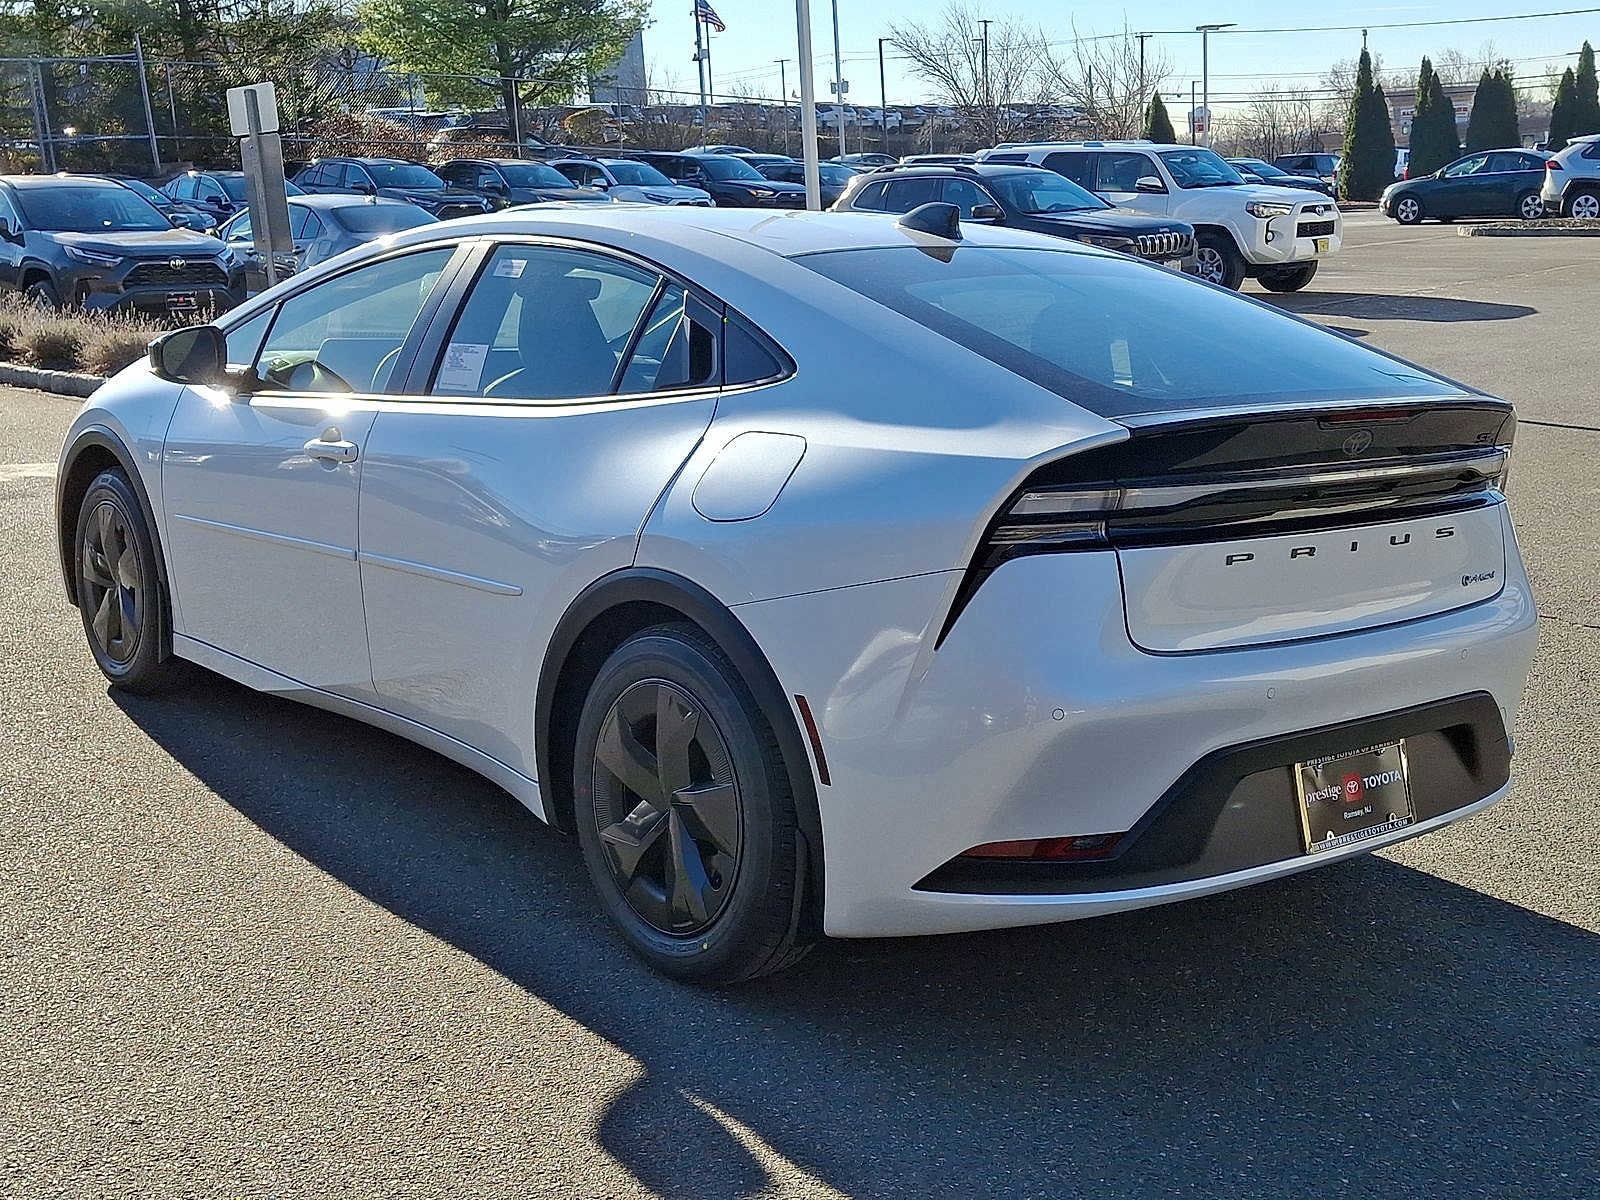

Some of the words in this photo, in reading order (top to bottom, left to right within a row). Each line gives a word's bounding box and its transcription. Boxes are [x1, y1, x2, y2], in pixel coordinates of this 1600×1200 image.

[1225, 526, 1455, 566] PRIUS
[1306, 785, 1342, 807] prestige
[1363, 770, 1401, 789] TOYOTA
[1364, 805, 1372, 814] NJ
